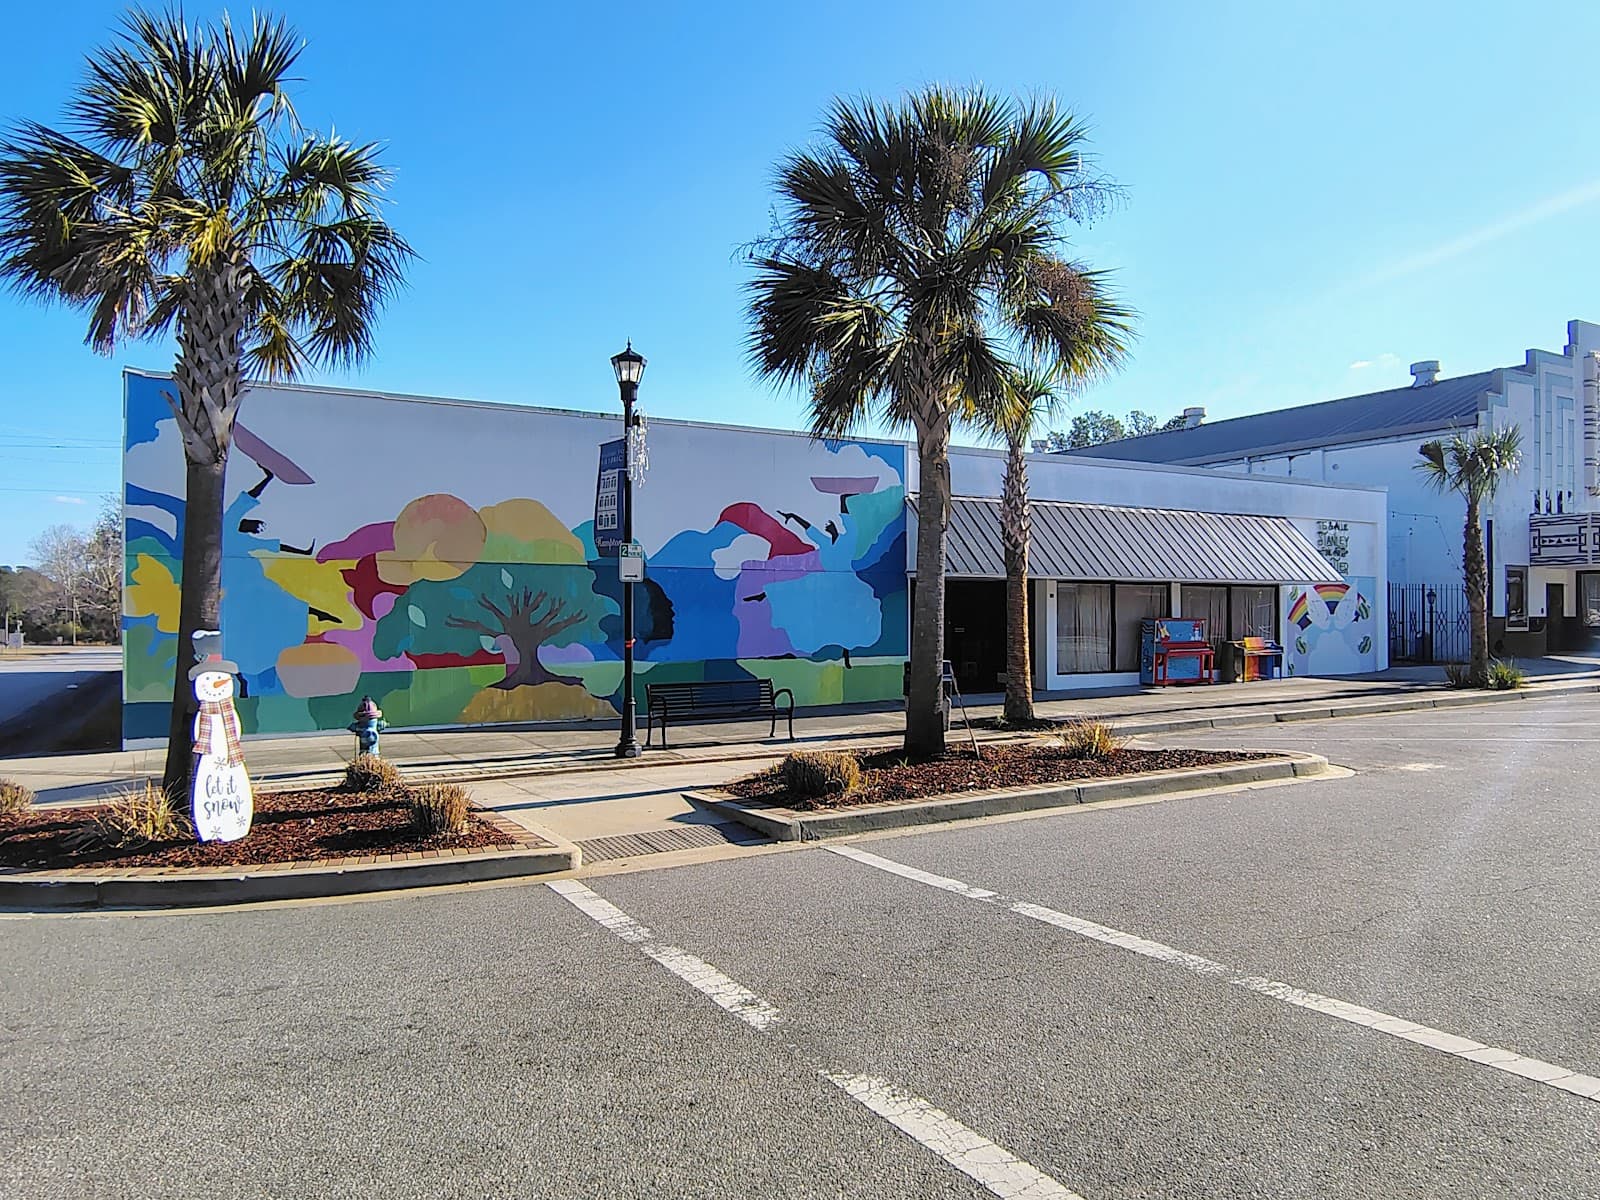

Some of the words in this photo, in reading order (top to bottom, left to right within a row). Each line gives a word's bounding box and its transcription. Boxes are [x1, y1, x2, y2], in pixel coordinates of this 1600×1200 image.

[1316, 531, 1349, 547] STANLEY
[621, 545, 628, 556] 2
[206, 774, 223, 798] Let
[226, 775, 237, 795] it
[203, 795, 244, 820] snow
